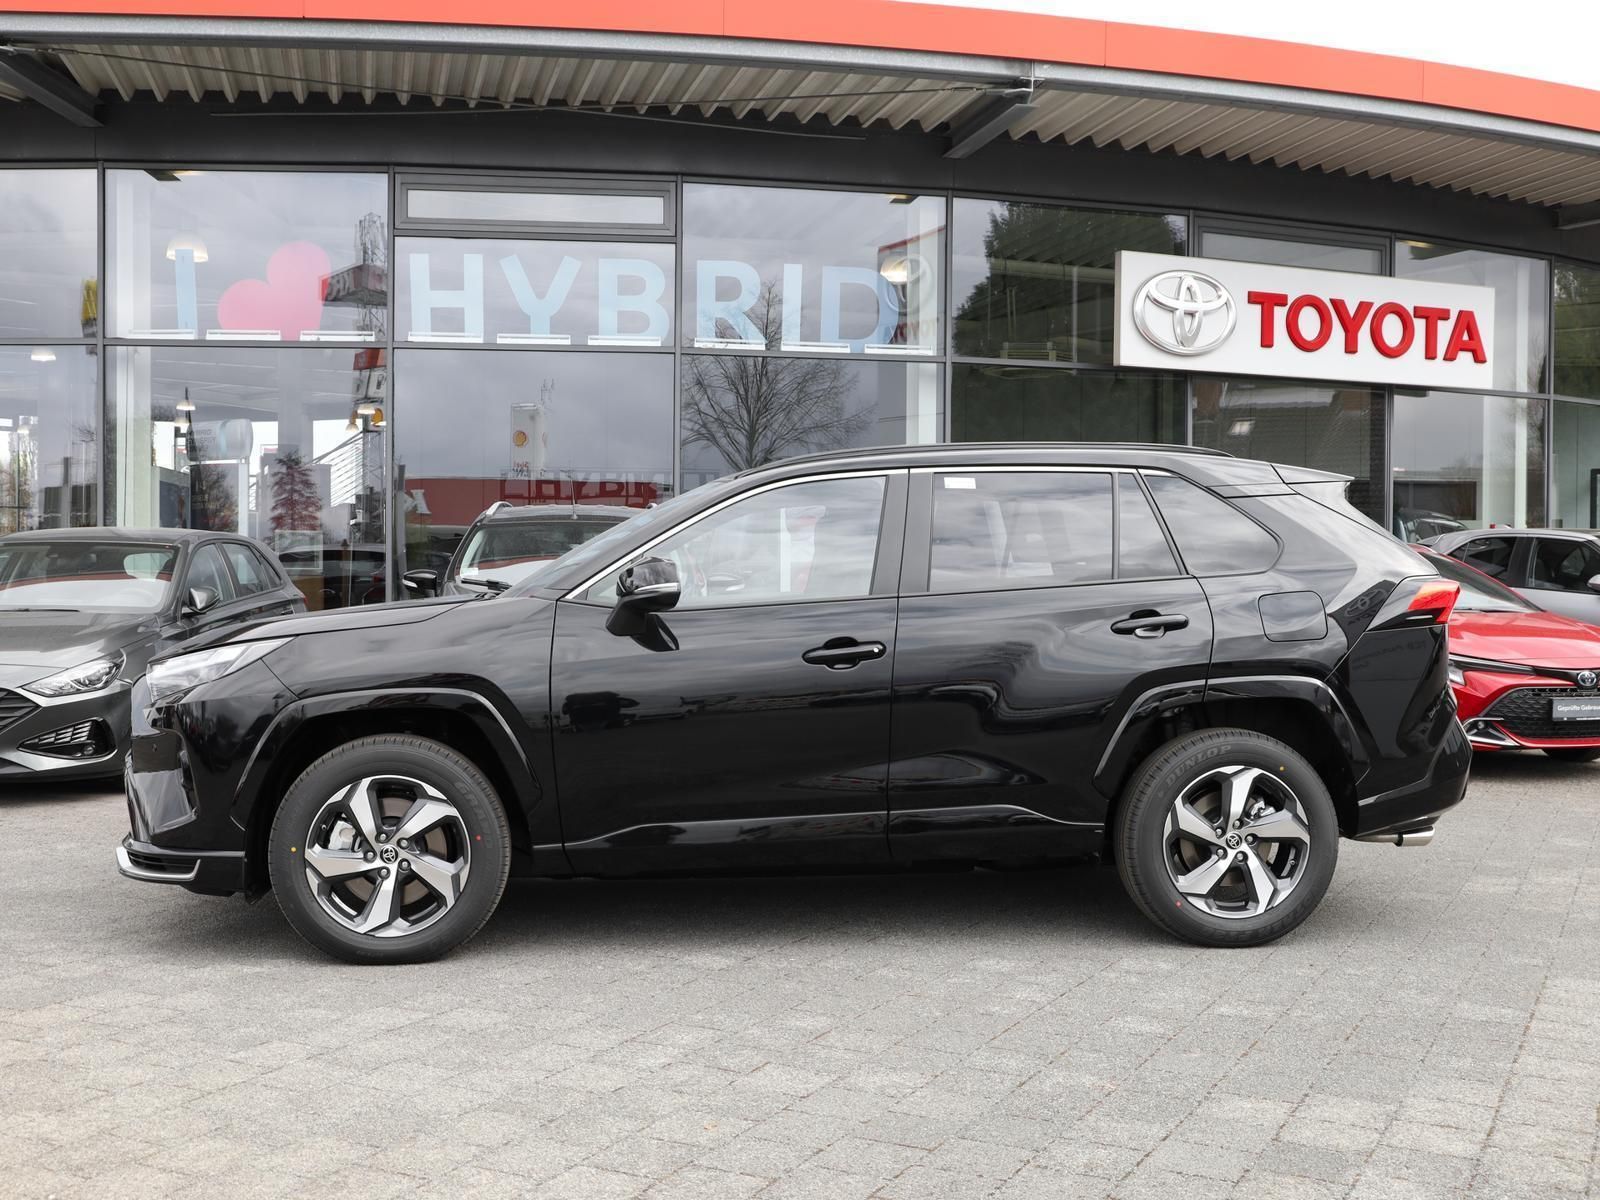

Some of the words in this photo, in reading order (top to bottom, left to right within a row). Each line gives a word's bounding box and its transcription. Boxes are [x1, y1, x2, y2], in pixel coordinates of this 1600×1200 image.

[409, 253, 899, 351] HYBRID
[1247, 290, 1486, 364] TOYOTA
[1165, 744, 1232, 786] DUNLOP
